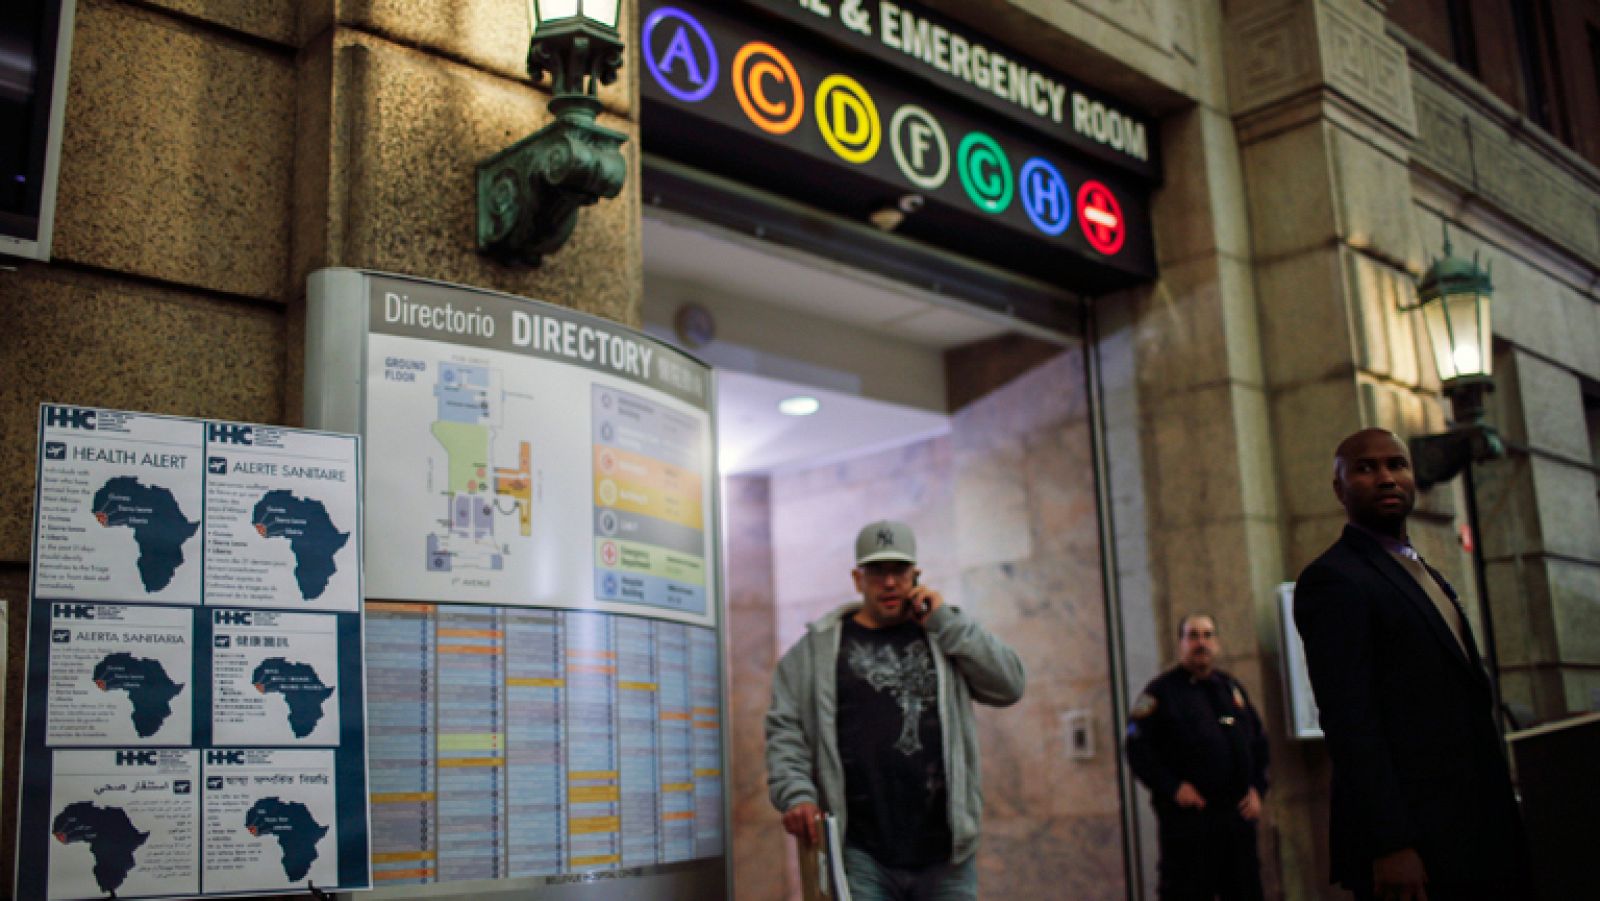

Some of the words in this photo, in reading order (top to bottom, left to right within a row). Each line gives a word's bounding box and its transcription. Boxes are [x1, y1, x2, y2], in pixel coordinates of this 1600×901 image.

[880, 1, 1064, 123] EMERGENCY
[1072, 92, 1149, 161] ROOM
[658, 24, 705, 84] A
[749, 61, 786, 116] C
[832, 89, 872, 145] D
[909, 121, 934, 170] F
[968, 147, 1002, 197] G
[1032, 171, 1061, 221] H
[384, 291, 495, 338] Directorio
[512, 310, 653, 379] DIRECTORY
[47, 406, 97, 430] HHC
[208, 423, 252, 446] HHC
[72, 446, 136, 465] HEALTH
[140, 452, 188, 470] ALERT
[232, 461, 278, 477] ALERTE
[282, 466, 347, 482] SANITAIRE
[53, 603, 95, 620] HHC
[214, 610, 252, 625] HHC
[75, 631, 120, 643] ALERTA
[122, 632, 185, 644] SANITARIA
[115, 750, 157, 766] HHC
[207, 750, 245, 765] HHC
